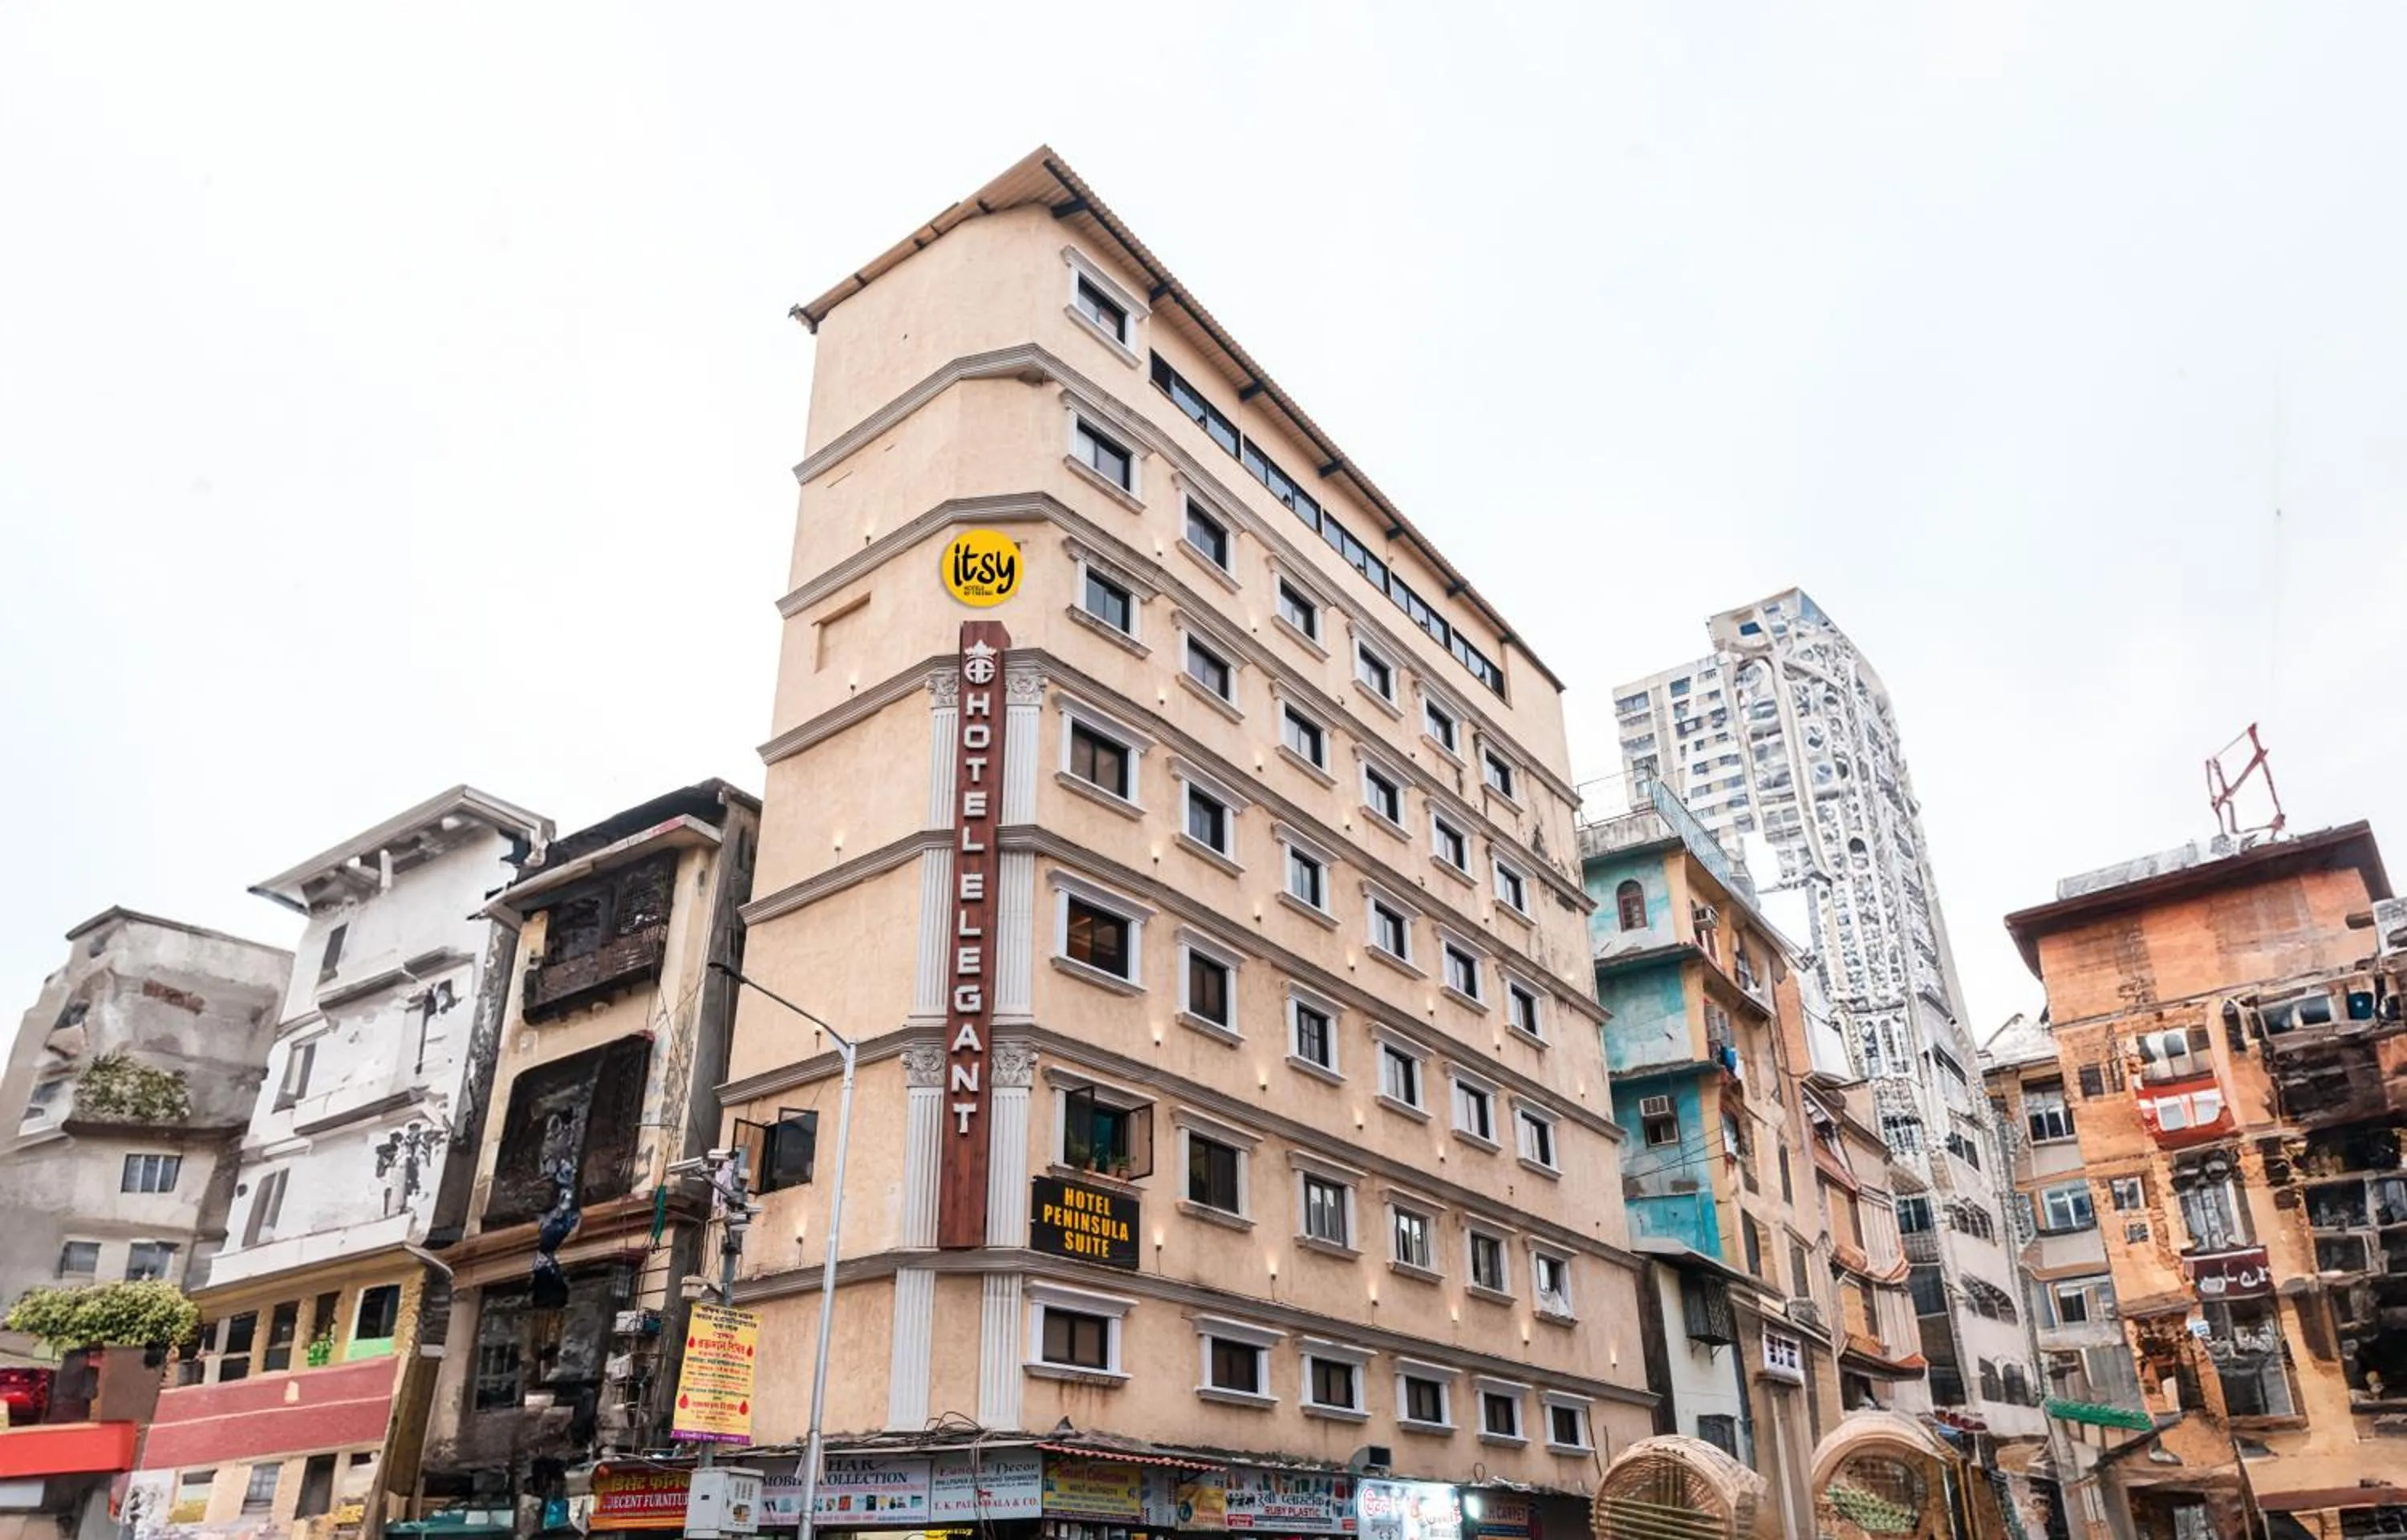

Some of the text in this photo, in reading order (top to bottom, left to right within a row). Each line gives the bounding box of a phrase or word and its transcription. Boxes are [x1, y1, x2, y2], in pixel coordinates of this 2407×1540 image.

[953, 543, 1015, 594] itsy
[951, 692, 990, 1133] HOTEL ELEGANT
[1065, 1187, 1111, 1216] HOTEL
[1044, 1204, 1129, 1241] PENINSULA
[1065, 1230, 1110, 1258] SUITE
[1264, 1506, 1321, 1517] RUBY PLASTIC
